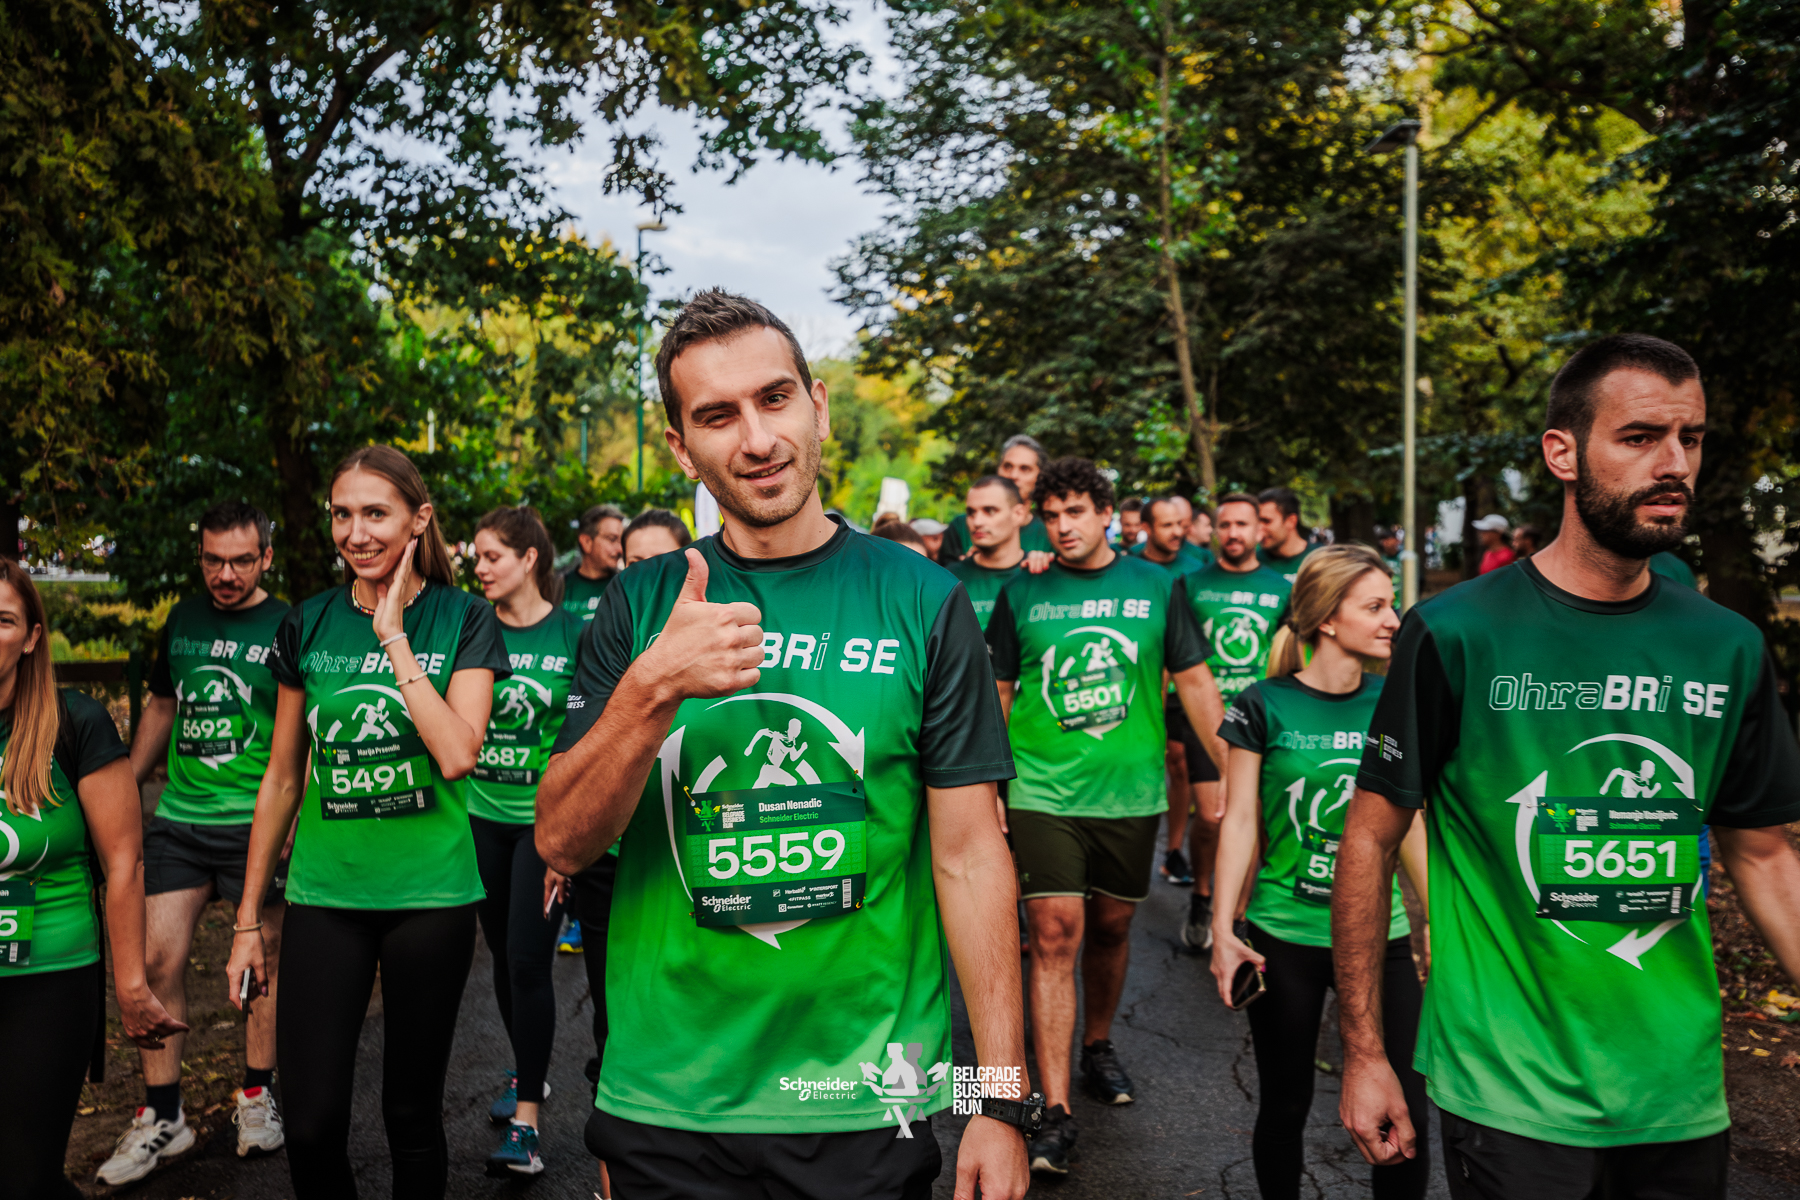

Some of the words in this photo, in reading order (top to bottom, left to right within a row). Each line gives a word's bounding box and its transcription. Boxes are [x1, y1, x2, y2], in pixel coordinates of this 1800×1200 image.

[1028, 598, 1119, 622] OhraBRi
[1122, 599, 1151, 618] SE
[303, 650, 394, 674] OhraBR
[414, 652, 445, 675] SE
[540, 655, 568, 673] SE
[839, 637, 900, 675] SE
[1063, 684, 1123, 712] 5501
[1488, 673, 1673, 713] OhraBRi
[1682, 681, 1729, 718] SE
[183, 718, 232, 739] 5692
[332, 761, 414, 794] 5491
[758, 802, 786, 813] Dusan
[787, 798, 822, 811] Nenadic
[759, 813, 793, 824] Schneider
[793, 811, 819, 821] Electric
[708, 829, 846, 880] 5559
[1563, 840, 1677, 879] 5651
[701, 895, 752, 908] Schneider
[721, 903, 752, 912] Electric
